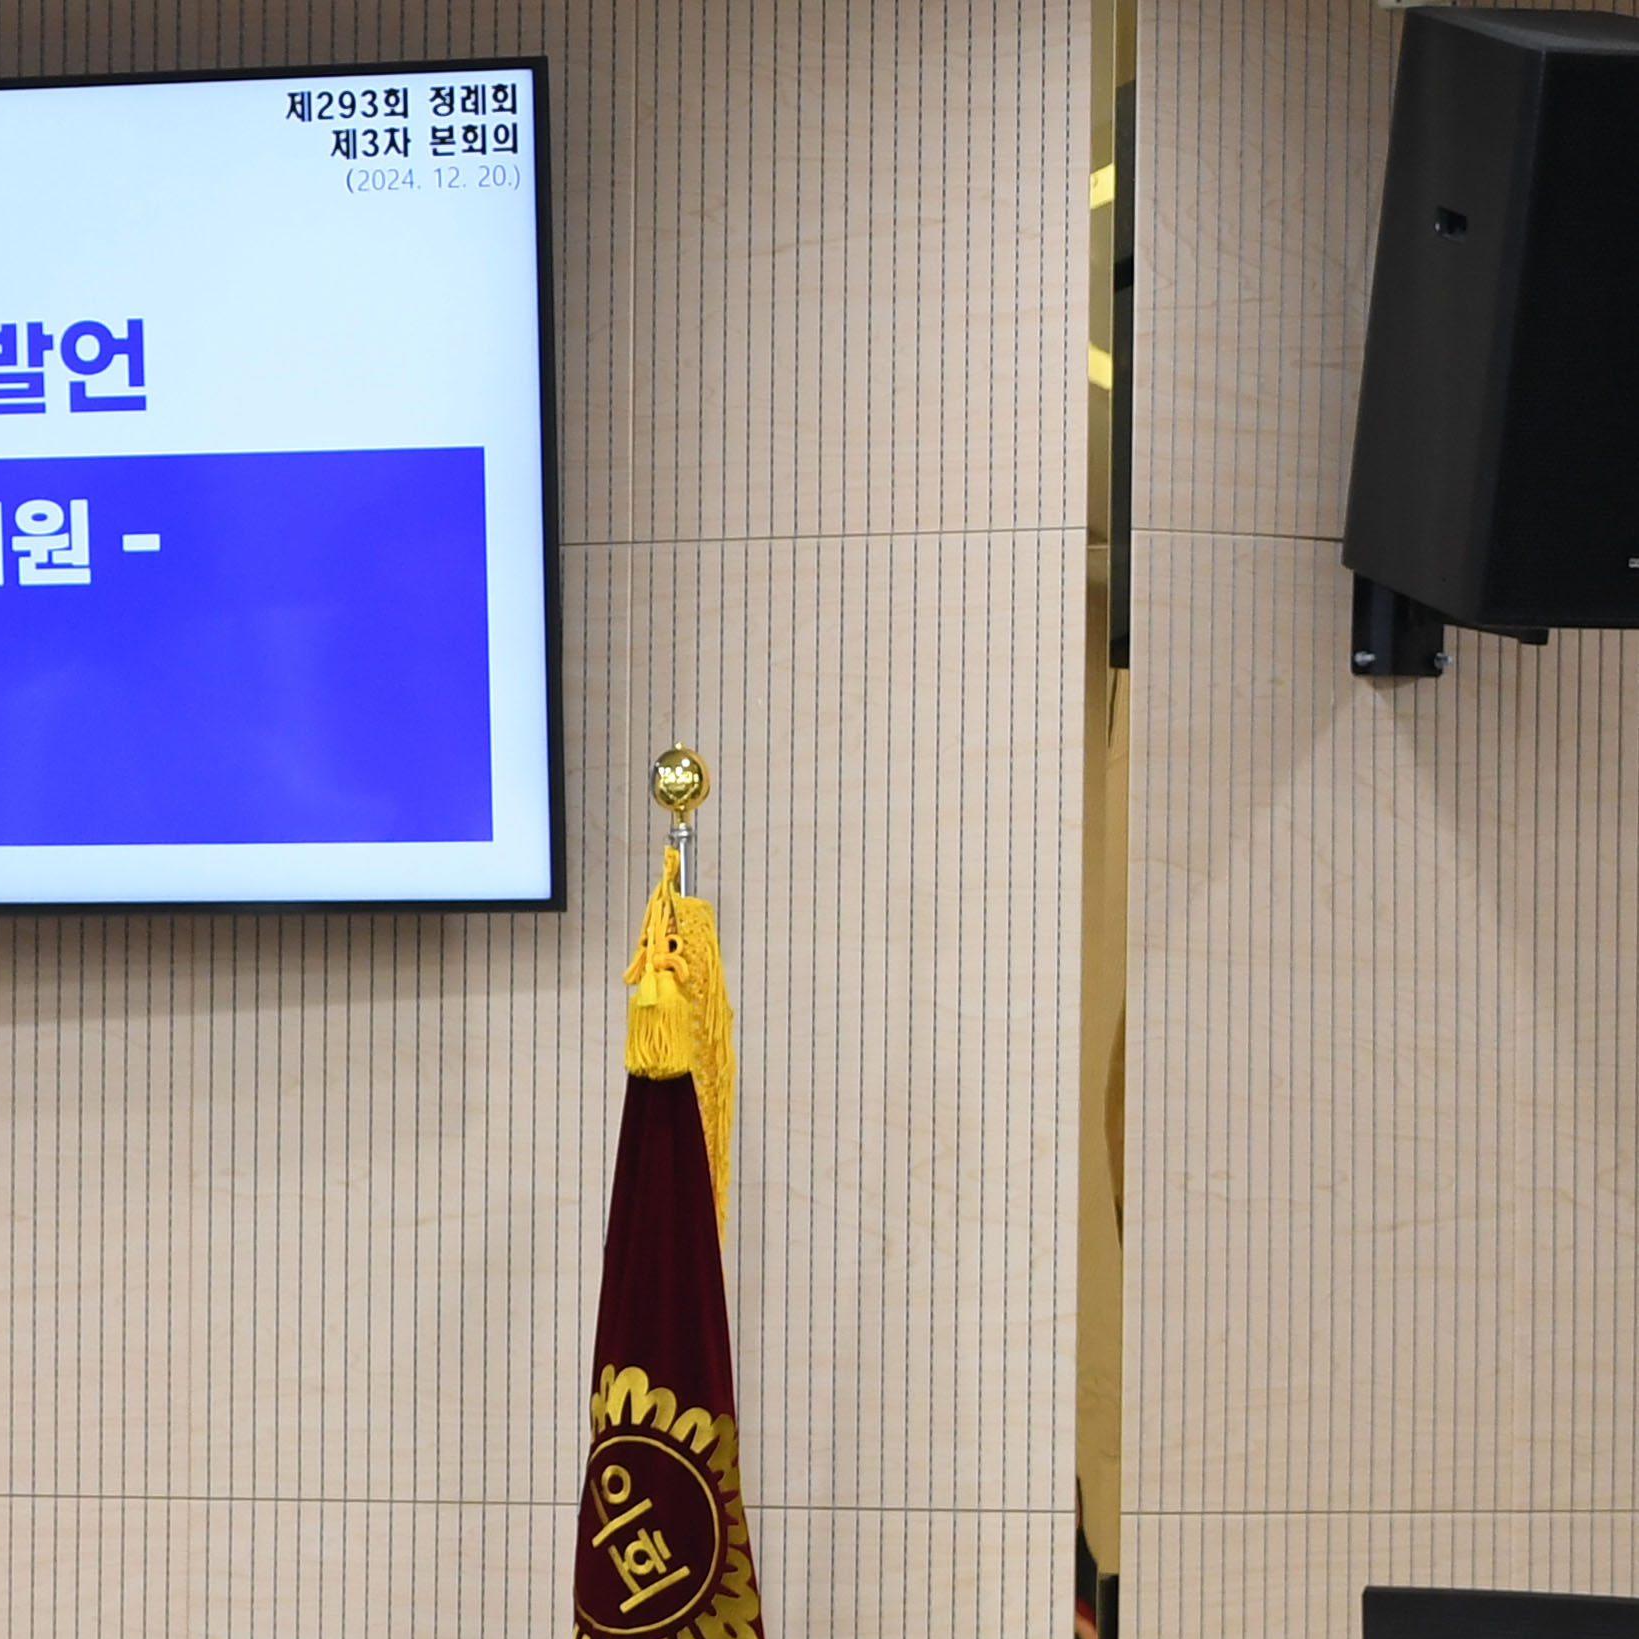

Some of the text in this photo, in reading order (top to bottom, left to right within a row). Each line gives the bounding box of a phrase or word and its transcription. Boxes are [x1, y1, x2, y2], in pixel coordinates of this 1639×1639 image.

[285, 83, 518, 122] 제293회 정례회
[330, 122, 519, 160] 제3차 본회의
[345, 163, 521, 194] (2024. 12. 20.)
[589, 1464, 692, 1614] 의회
